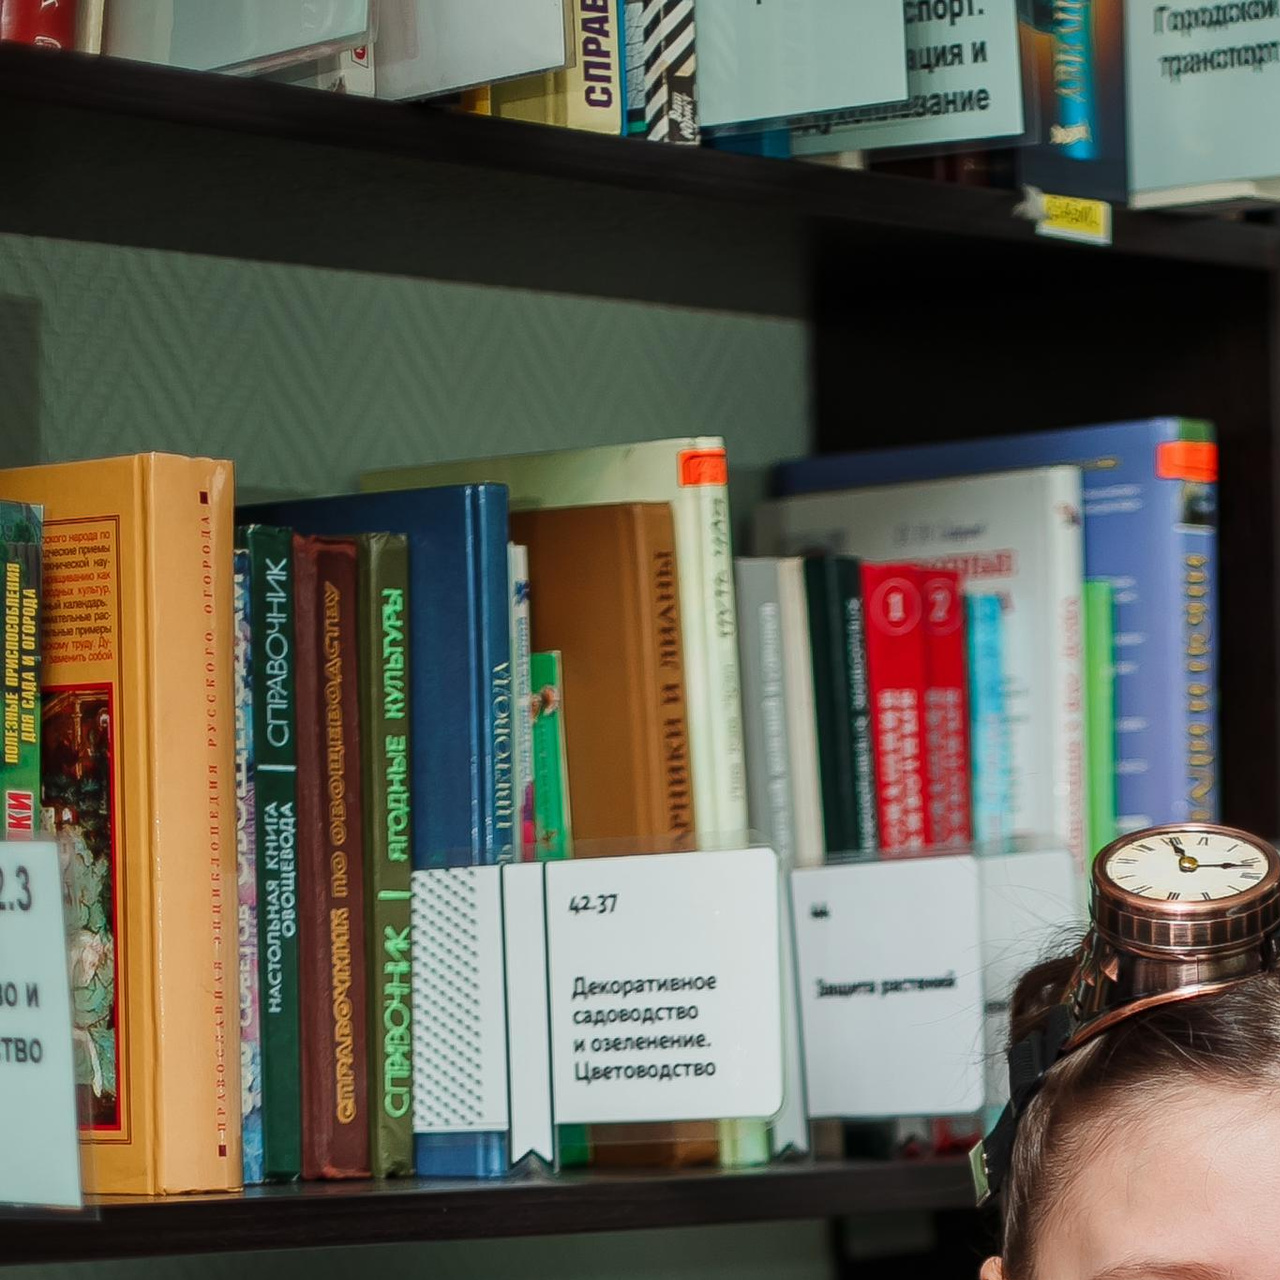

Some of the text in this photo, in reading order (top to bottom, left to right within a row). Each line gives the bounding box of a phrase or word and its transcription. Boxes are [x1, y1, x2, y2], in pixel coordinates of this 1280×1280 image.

[3, 562, 21, 764] ПОЛЕЗНЫЕ ПРИСПОСОБЛЕНИЯ
[21, 587, 38, 744] ДЛЯ САДА И ОГОРОДА
[264, 556, 290, 748] СПРАВОЧНИК
[887, 592, 906, 622] 1
[381, 586, 410, 862] ЯГОДНЫЕ КУЛЬТУРЫ
[201, 514, 226, 1134] ПРАВОСЛАВНАЯ ЭНЦИКЛОПЕДИЯ РУССКОГО ОГОРОДА
[264, 800, 282, 1013] НАСТОЛЬНАЯ КНИГА
[279, 802, 297, 939] ОВОЩЕВОДА
[324, 580, 356, 1125] СПРАВОЧНИК ПО ОВОЩЕВОДСТВУ
[384, 925, 411, 1119] СПРАВОЧНИК
[572, 975, 717, 1000] Декоративное
[573, 1005, 699, 1027] садоводство
[574, 1033, 712, 1053] и озеленение.
[574, 1061, 716, 1085] Цветоводство
